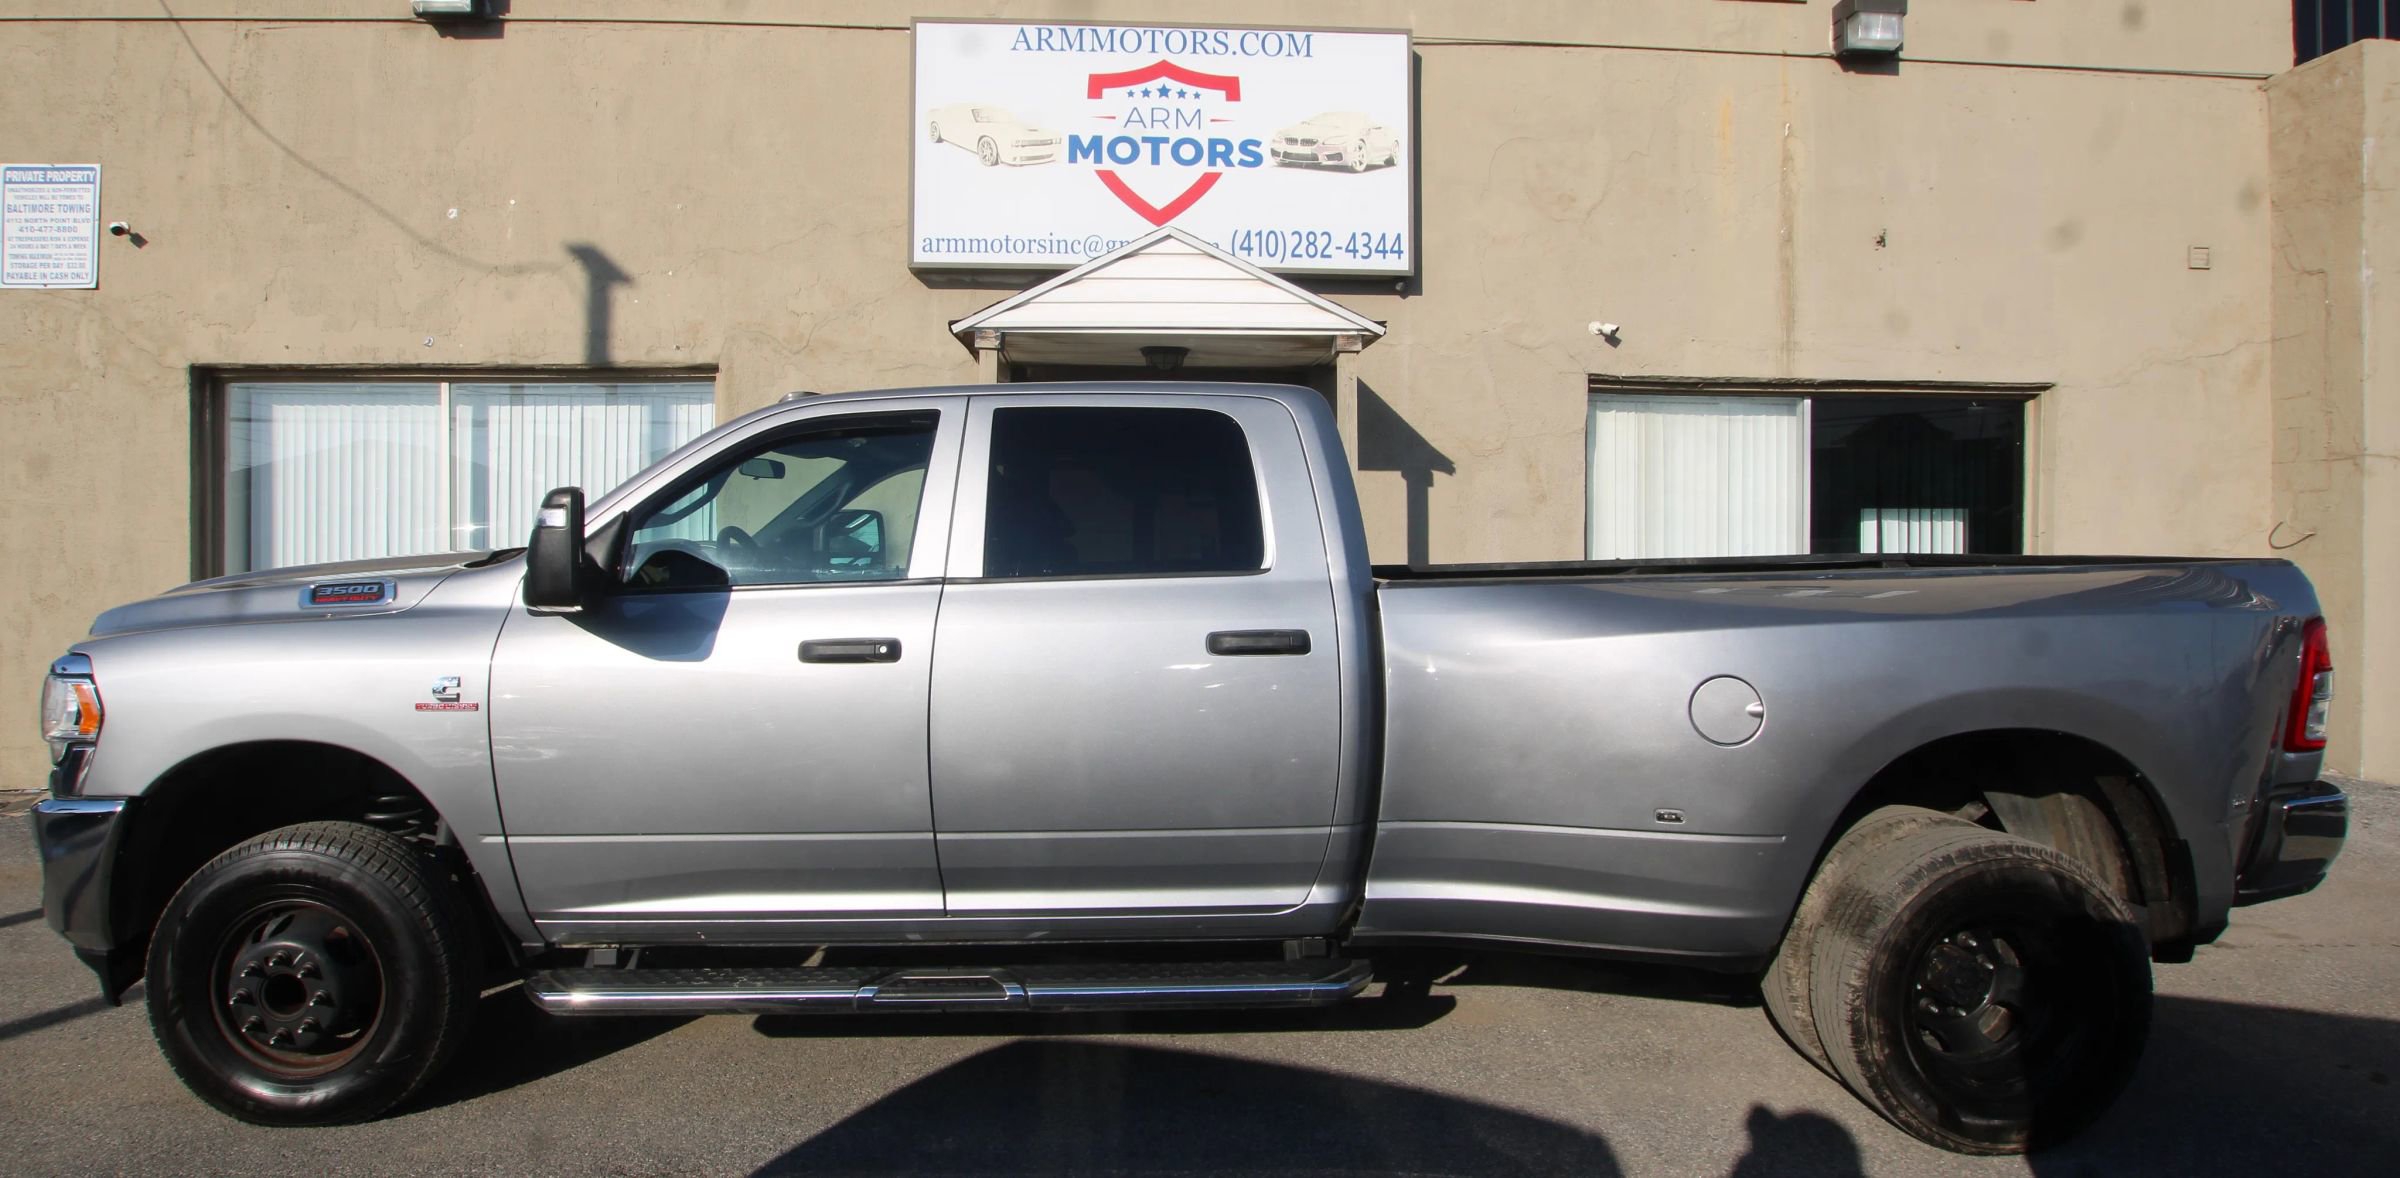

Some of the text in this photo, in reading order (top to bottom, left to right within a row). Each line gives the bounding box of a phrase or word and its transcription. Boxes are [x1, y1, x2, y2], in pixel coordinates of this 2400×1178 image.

[1011, 26, 1314, 58] ARMMOTORS.COM
[1123, 106, 1202, 130] ARM
[1068, 133, 1264, 168] MOTORS
[6, 170, 95, 182] PRIVATE PROPERTY
[7, 203, 90, 213] BALTIMORE TOWING
[7, 272, 89, 280] PAYABLE IN CASH ONLY
[318, 584, 379, 595] 3500
